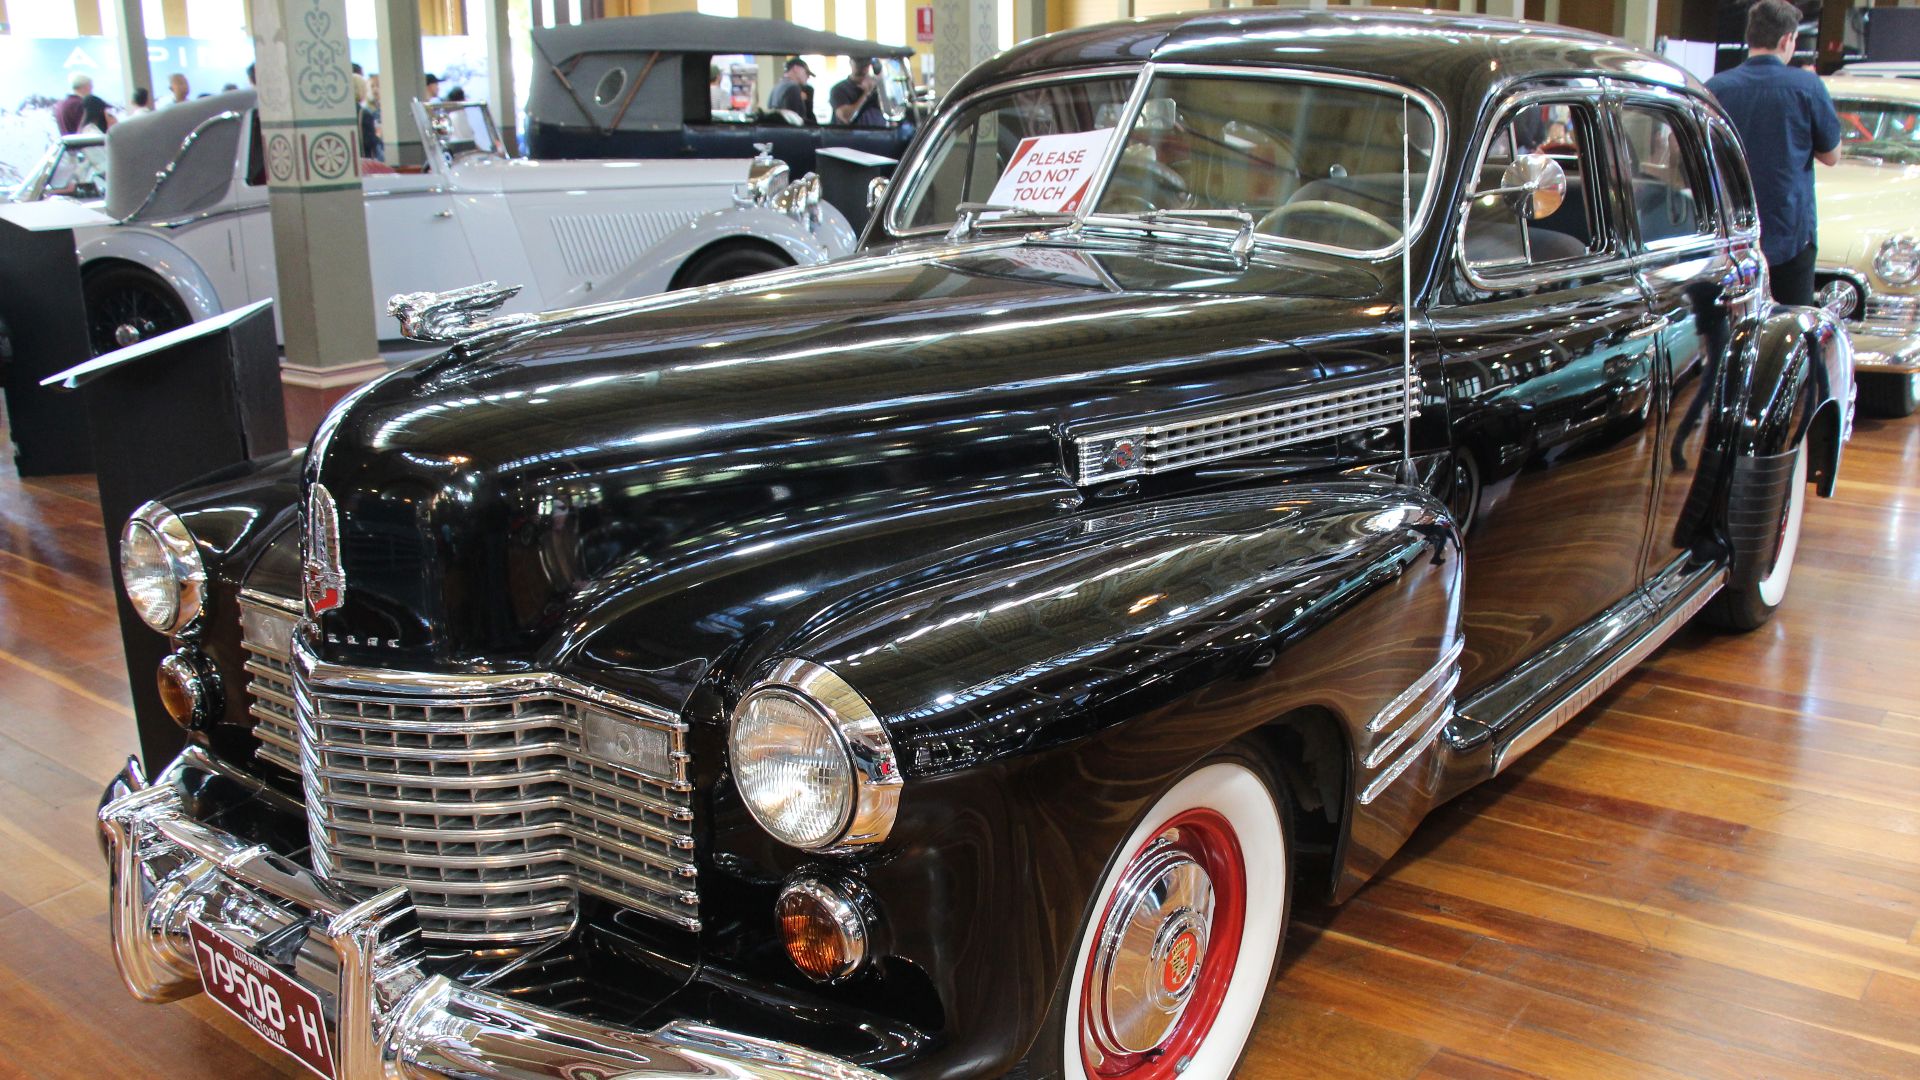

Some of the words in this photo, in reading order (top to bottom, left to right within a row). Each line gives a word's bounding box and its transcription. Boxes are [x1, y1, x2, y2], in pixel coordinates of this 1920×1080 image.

[1027, 149, 1087, 167] PLEASE
[1017, 170, 1042, 184] DO
[1043, 168, 1080, 183] NOT
[1013, 186, 1067, 201] TOUCH
[245, 1009, 287, 1047] VICTORIA
